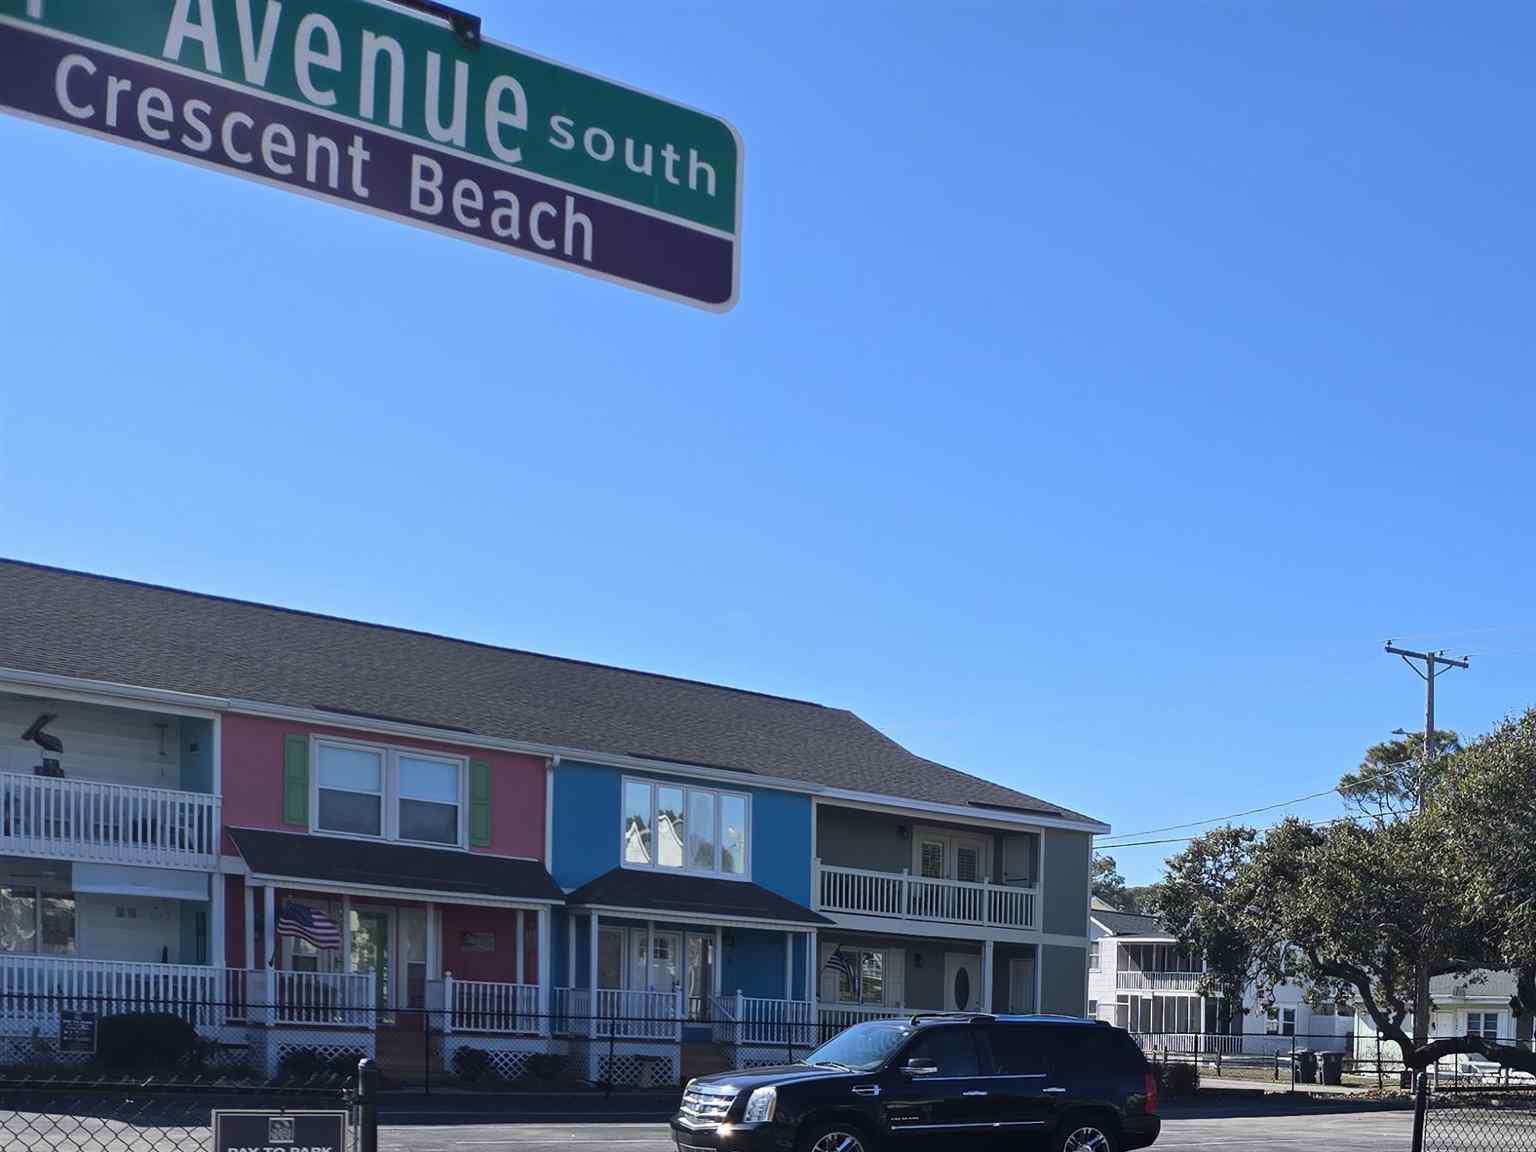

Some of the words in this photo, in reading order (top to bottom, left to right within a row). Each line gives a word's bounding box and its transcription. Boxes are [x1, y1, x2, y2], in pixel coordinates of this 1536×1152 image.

[54, 53, 371, 199] Crescent
[409, 153, 594, 262] Beach
[162, 0, 528, 163] Avenue
[549, 111, 717, 197] south
